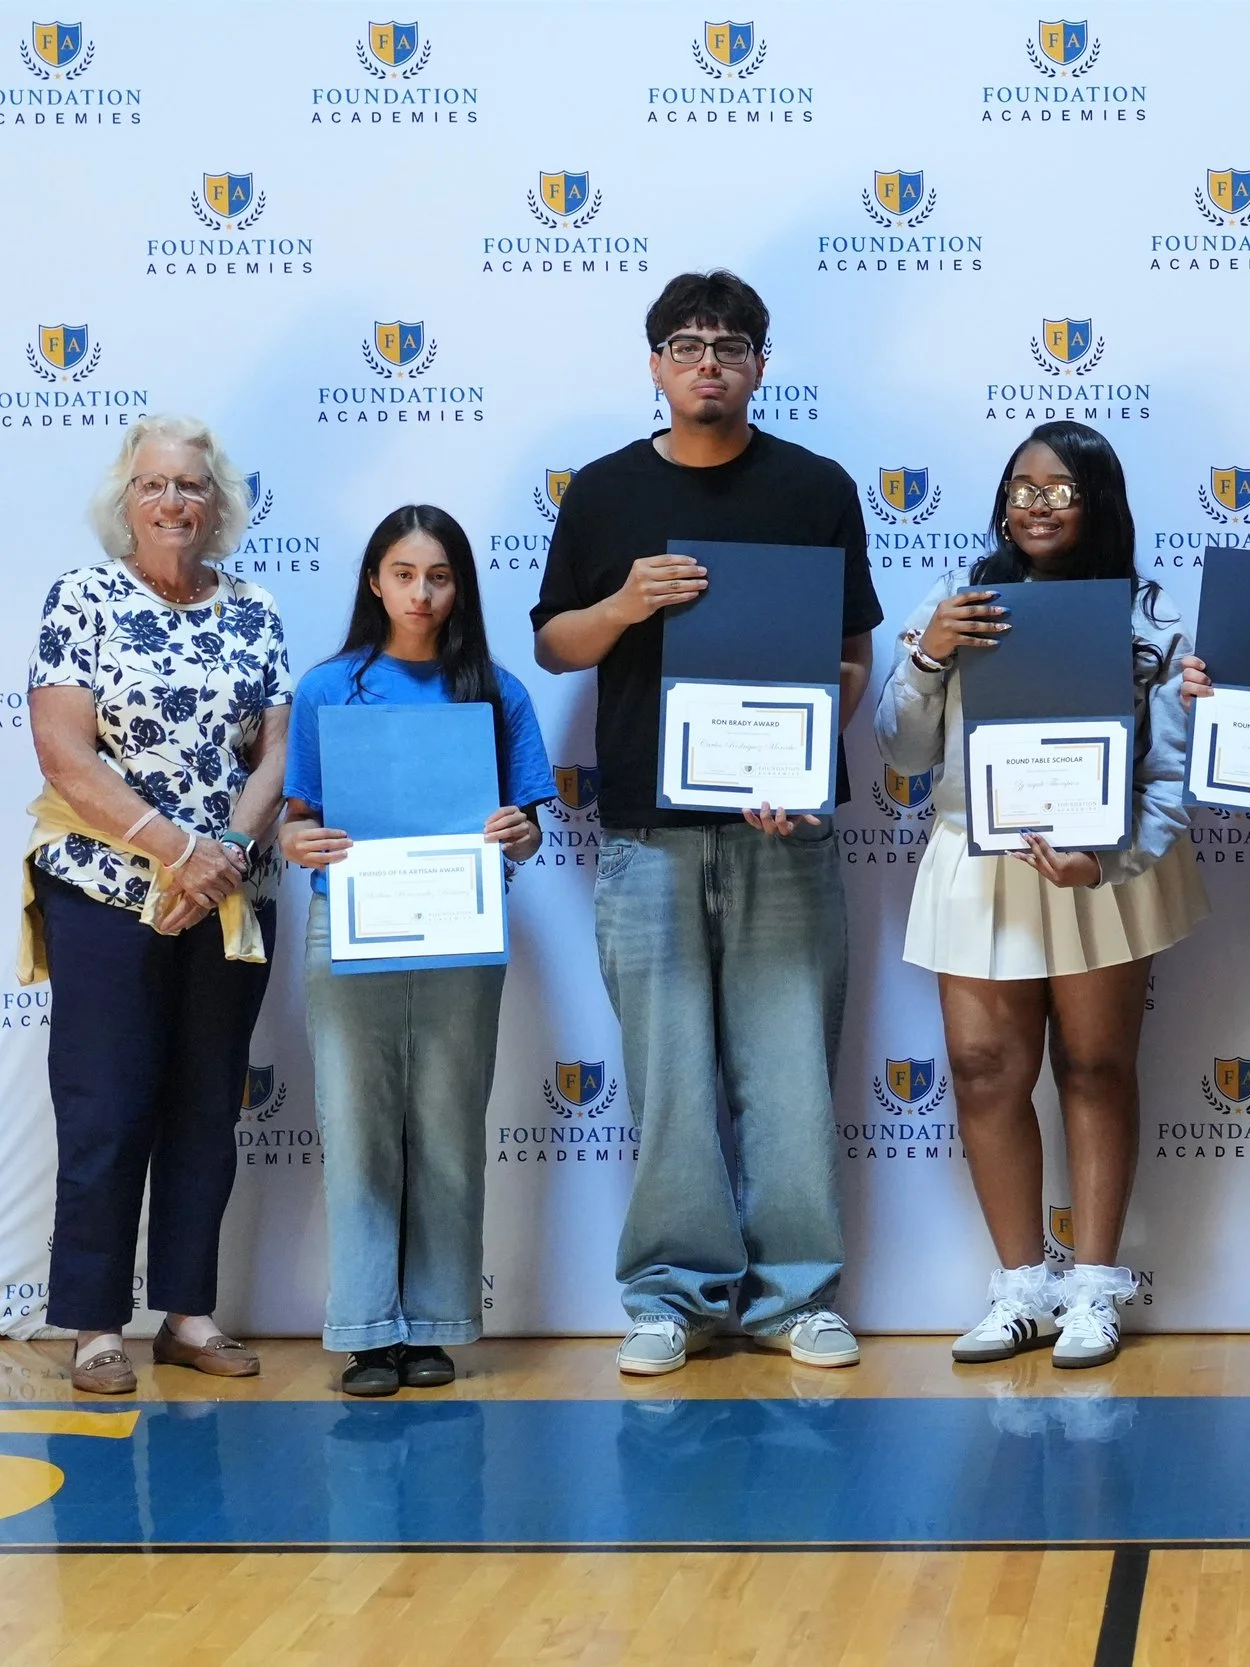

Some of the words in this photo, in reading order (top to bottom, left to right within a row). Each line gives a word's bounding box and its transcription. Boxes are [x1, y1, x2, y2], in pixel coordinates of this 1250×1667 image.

[0, 89, 142, 106] UNDATION
[312, 88, 478, 105] FOUNDATION
[648, 87, 814, 104] FOUNDATION
[983, 86, 1147, 103] FOUNDATION
[0, 112, 141, 125] ADEMIES
[311, 111, 478, 124] ACADEMIES
[647, 110, 813, 123] ACADEMIES
[981, 108, 1146, 122] ACADEMIES
[147, 238, 313, 256] FOUNDATION
[483, 237, 649, 254] FOUNDATION
[818, 236, 982, 253] FOUNDATION
[146, 261, 313, 275] ACADEMIES
[482, 260, 648, 273] ACADEMIES
[817, 259, 982, 272] ACADEMIES
[0, 390, 148, 409] OUNDATION
[318, 386, 483, 404] FOUNDATION
[987, 384, 1151, 401] FOUNDATION
[317, 409, 484, 423] ACADEMIES
[985, 407, 1150, 420] ACADEMIES
[711, 718, 728, 726] RON
[728, 719, 752, 727] BRADY
[753, 720, 780, 728] AWARD
[359, 870, 387, 878] FRIENDS
